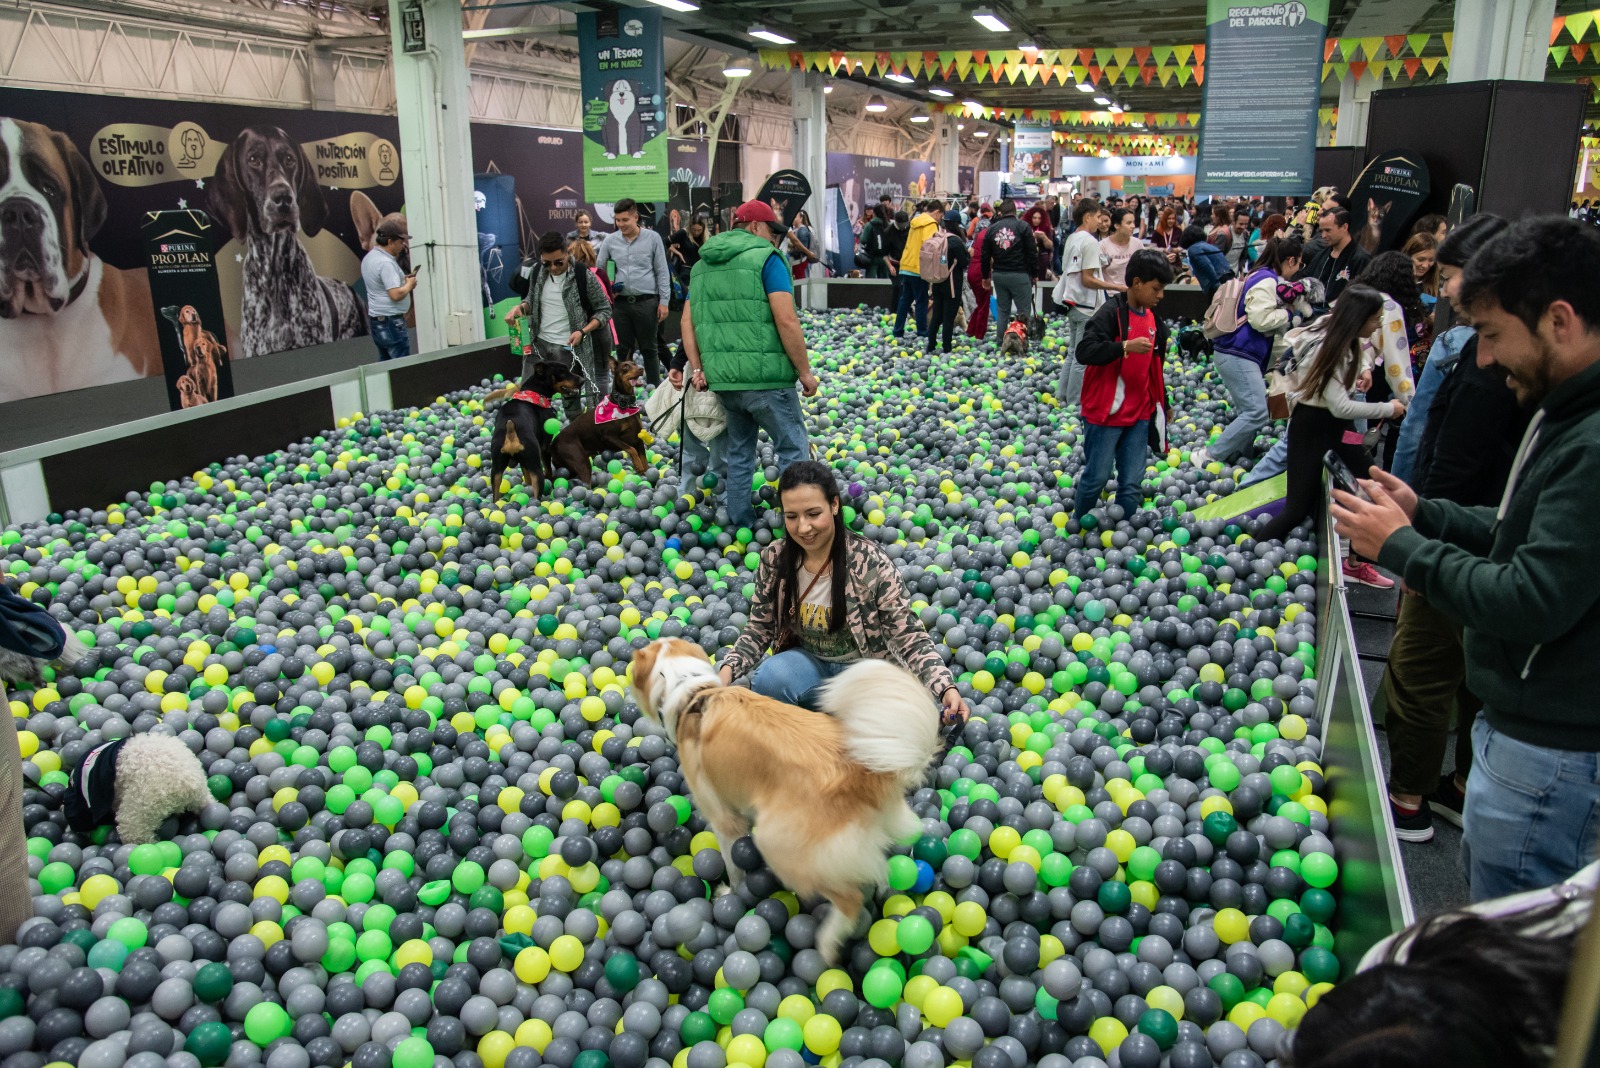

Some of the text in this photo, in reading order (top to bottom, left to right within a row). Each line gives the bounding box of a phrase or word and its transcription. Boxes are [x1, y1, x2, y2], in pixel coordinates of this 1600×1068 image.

[1228, 4, 1285, 18] REGLAMENTO
[1229, 16, 1283, 28] DEL PARQUE
[598, 47, 643, 60] UN TESORO
[599, 59, 643, 70] EN MI NARIZ
[98, 133, 165, 156] ESTIMULO
[315, 142, 367, 160] NUTRICIÓN
[102, 155, 165, 176] OLFATIVO
[318, 161, 359, 178] POSITIVA
[1390, 168, 1411, 176] PURINA
[1374, 174, 1420, 188] PRO PLAN
[549, 209, 580, 219] PRO PLA
[151, 252, 209, 265] PRO PLAN
